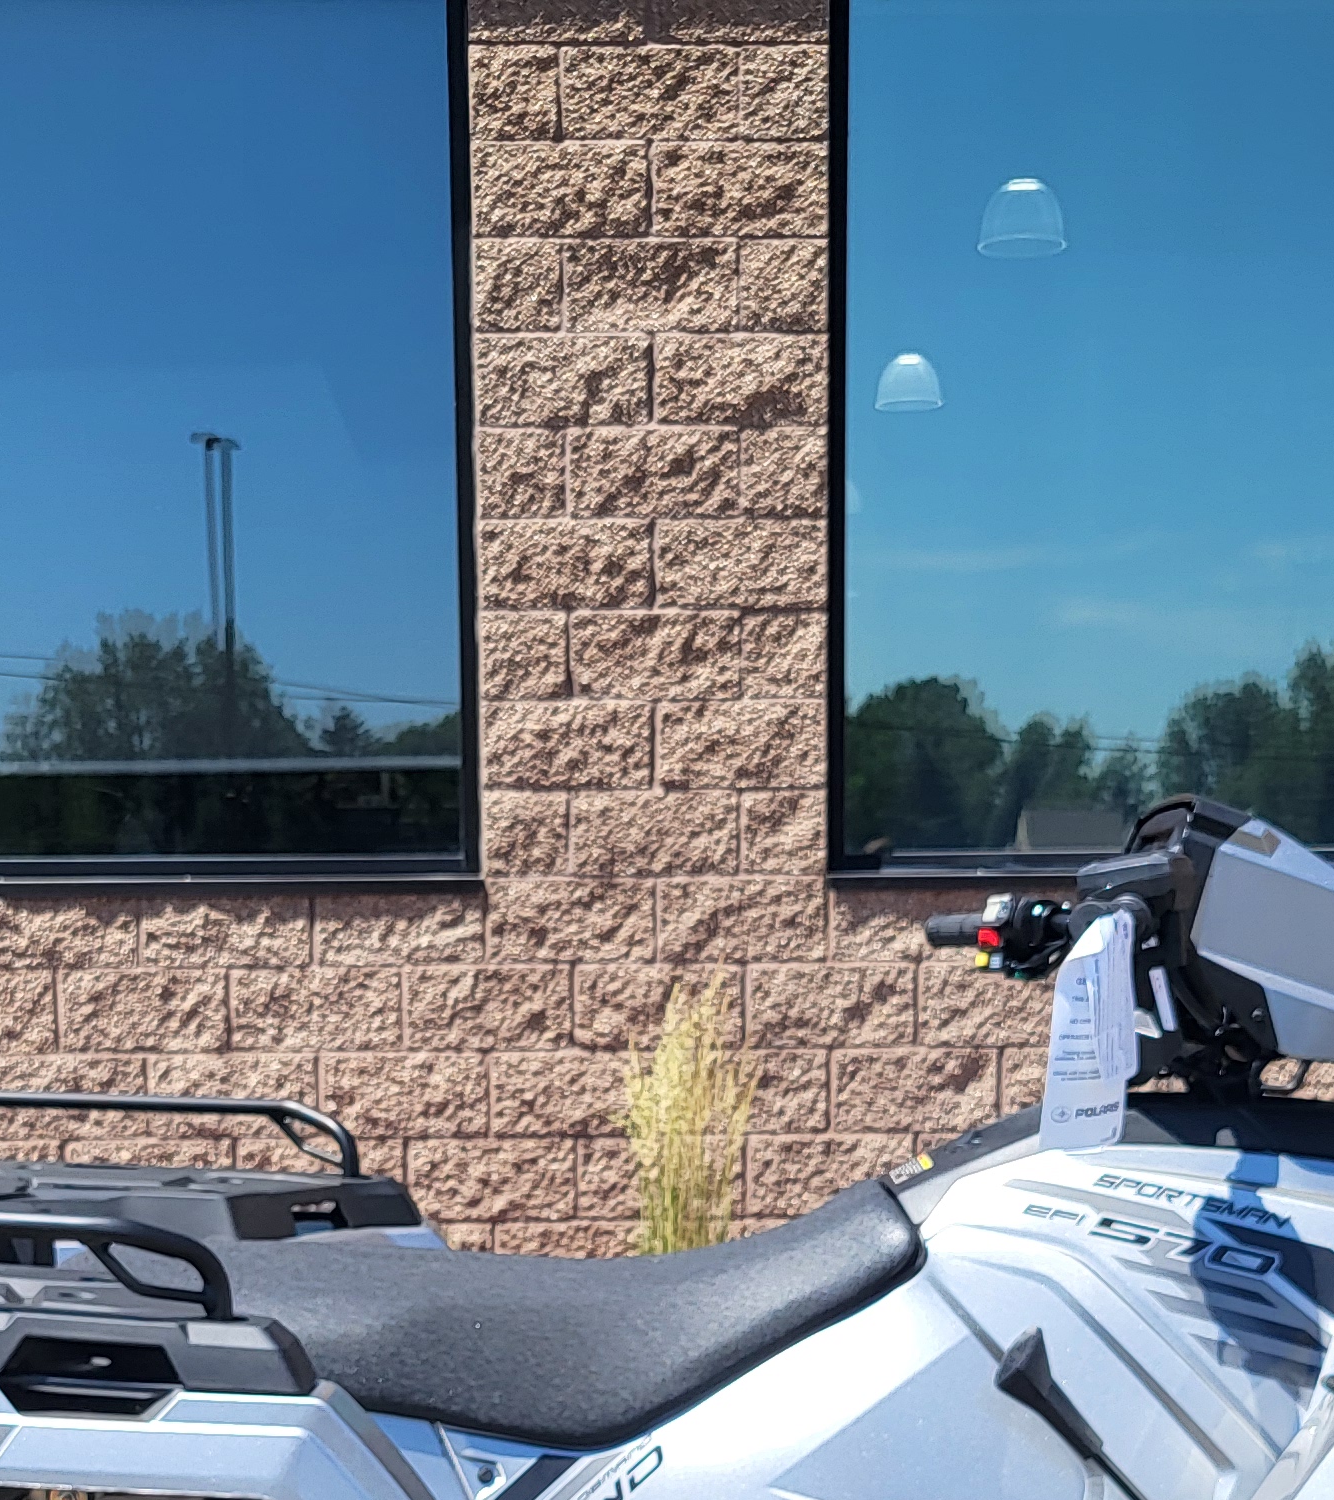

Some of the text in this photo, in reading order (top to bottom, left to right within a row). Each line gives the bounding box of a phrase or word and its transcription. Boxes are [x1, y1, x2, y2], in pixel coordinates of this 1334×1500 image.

[1075, 1101, 1119, 1119] POLARIS
[1092, 1173, 1292, 1229] SPORTSMAN
[1022, 1203, 1277, 1276] EFI 570
